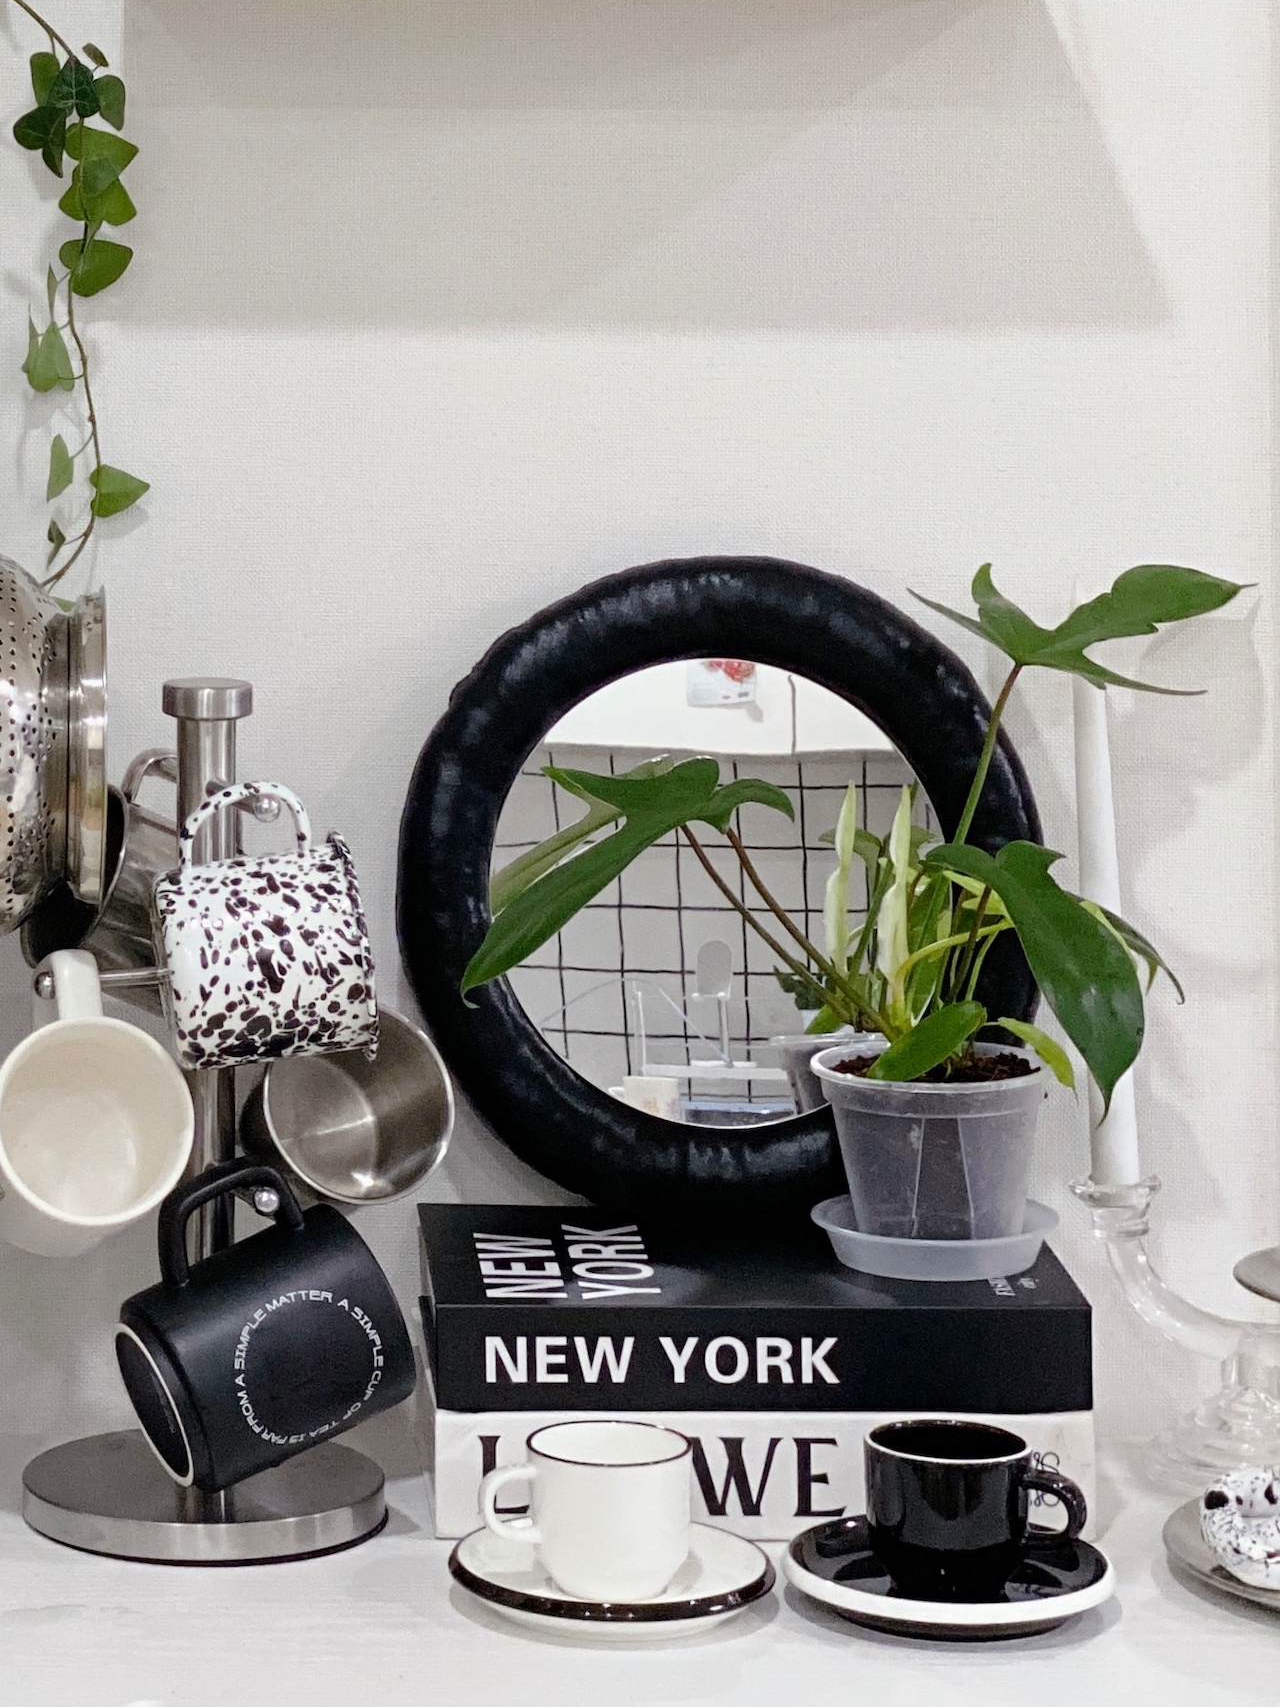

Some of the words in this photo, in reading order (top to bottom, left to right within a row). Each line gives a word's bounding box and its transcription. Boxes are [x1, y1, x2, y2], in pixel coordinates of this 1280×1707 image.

[472, 1232, 569, 1299] NEW
[560, 1223, 662, 1300] YORK
[264, 1289, 334, 1313] MATTER
[337, 1298, 350, 1312] A
[233, 1308, 267, 1371] SIMPLE
[350, 1306, 384, 1368] SIMPLE
[484, 1335, 635, 1385] NEW
[658, 1335, 841, 1385] YORK
[234, 1373, 247, 1388] A
[363, 1370, 382, 1402] CUP
[236, 1389, 265, 1434] FROM
[308, 1420, 340, 1438] TEA
[342, 1401, 362, 1421] OF
[260, 1427, 290, 1445] FAR
[478, 1434, 847, 1518] LWE
